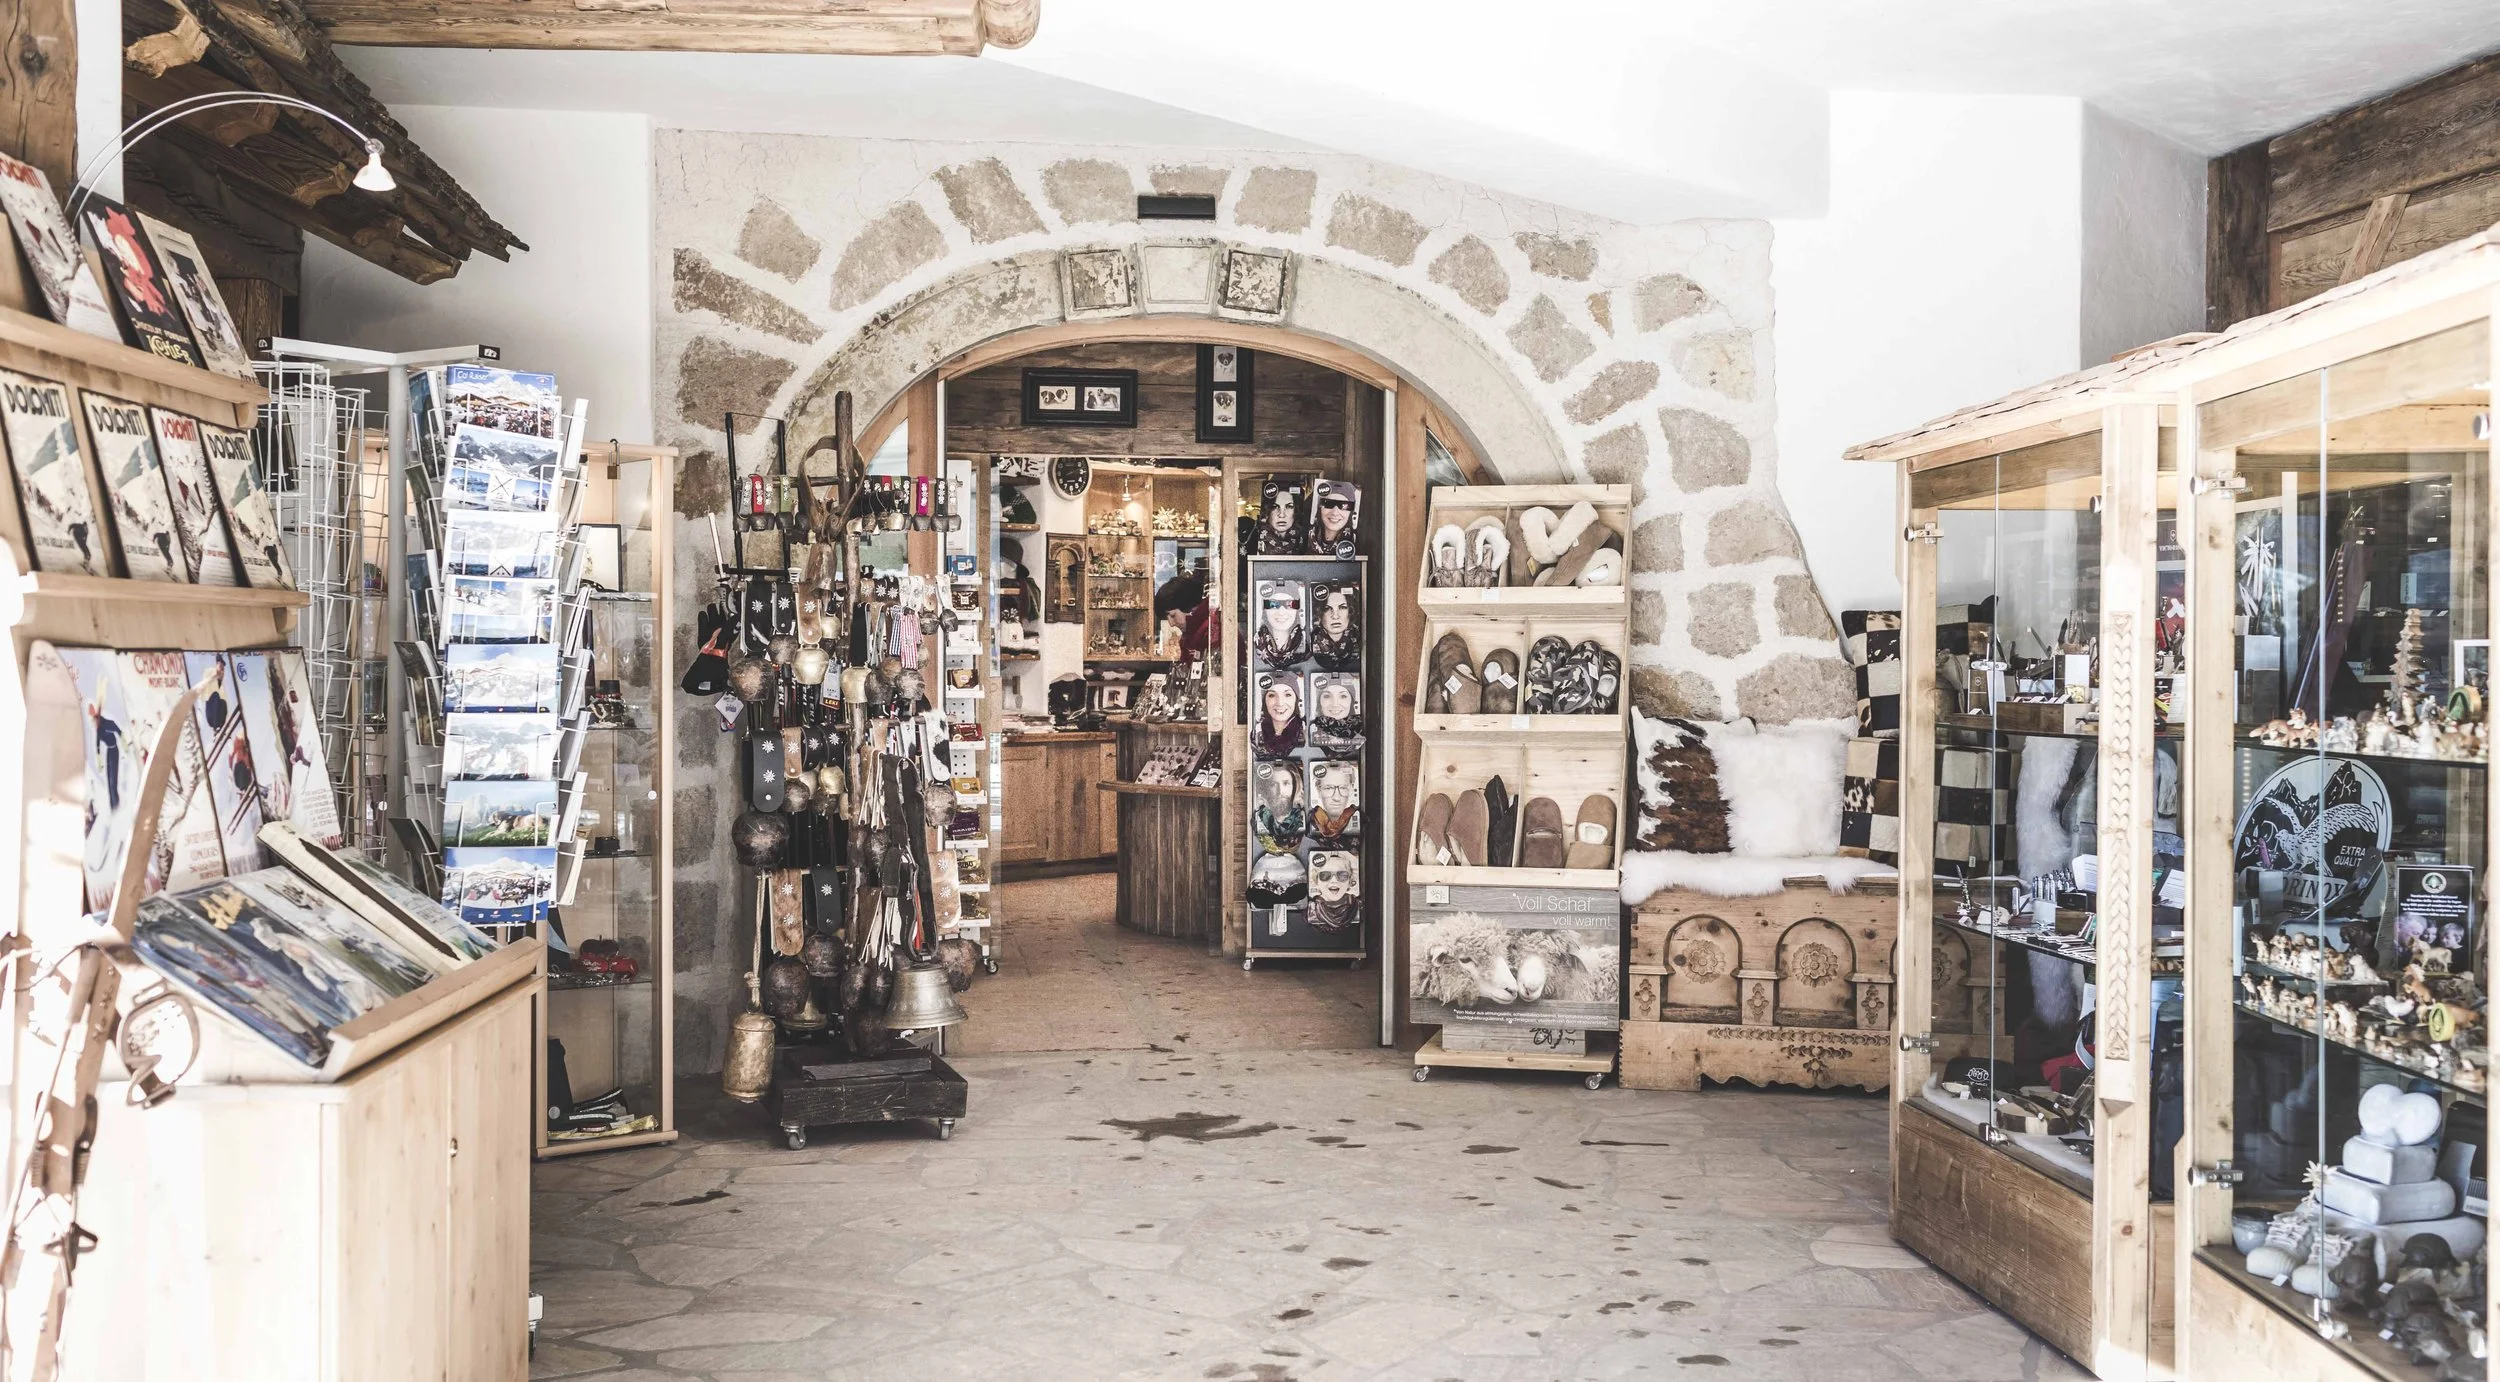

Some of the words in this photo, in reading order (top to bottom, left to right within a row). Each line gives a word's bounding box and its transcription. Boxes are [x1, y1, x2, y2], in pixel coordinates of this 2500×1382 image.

[0, 158, 42, 189] OLOMITI
[3, 382, 66, 418] DOLOMITI
[90, 403, 147, 437] DOLOMITI
[160, 416, 198, 442] DOLOMITI
[206, 433, 252, 461] DOLOMITI
[1265, 487, 1277, 495] HAD
[1338, 546, 1353, 555] HAD
[1315, 589, 1327, 597] HAD
[1260, 679, 1272, 687] HAD
[824, 698, 839, 706] LEKI
[2340, 845, 2366, 856] EXTRA
[2334, 855, 2362, 867] QUALIT
[1552, 914, 1572, 926] voll
[1574, 915, 1611, 927] warm!
